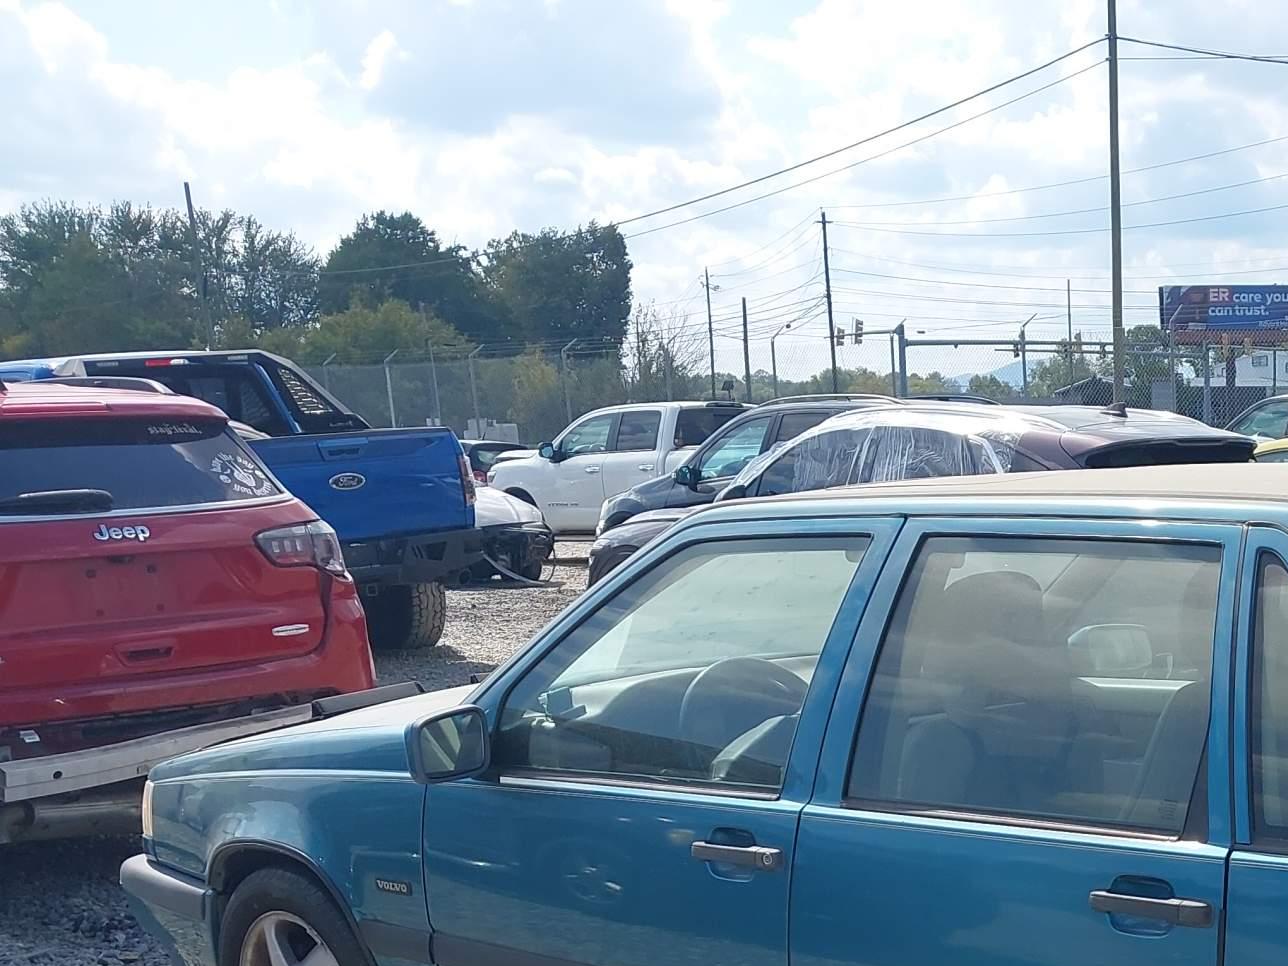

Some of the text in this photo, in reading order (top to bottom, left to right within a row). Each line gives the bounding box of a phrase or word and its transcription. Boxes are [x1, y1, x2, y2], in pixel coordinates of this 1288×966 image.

[1209, 288, 1230, 301] ER
[1232, 293, 1262, 302] care
[1208, 305, 1270, 316] can trust.
[93, 524, 150, 541] Jeep
[376, 879, 407, 893] VOLVO
